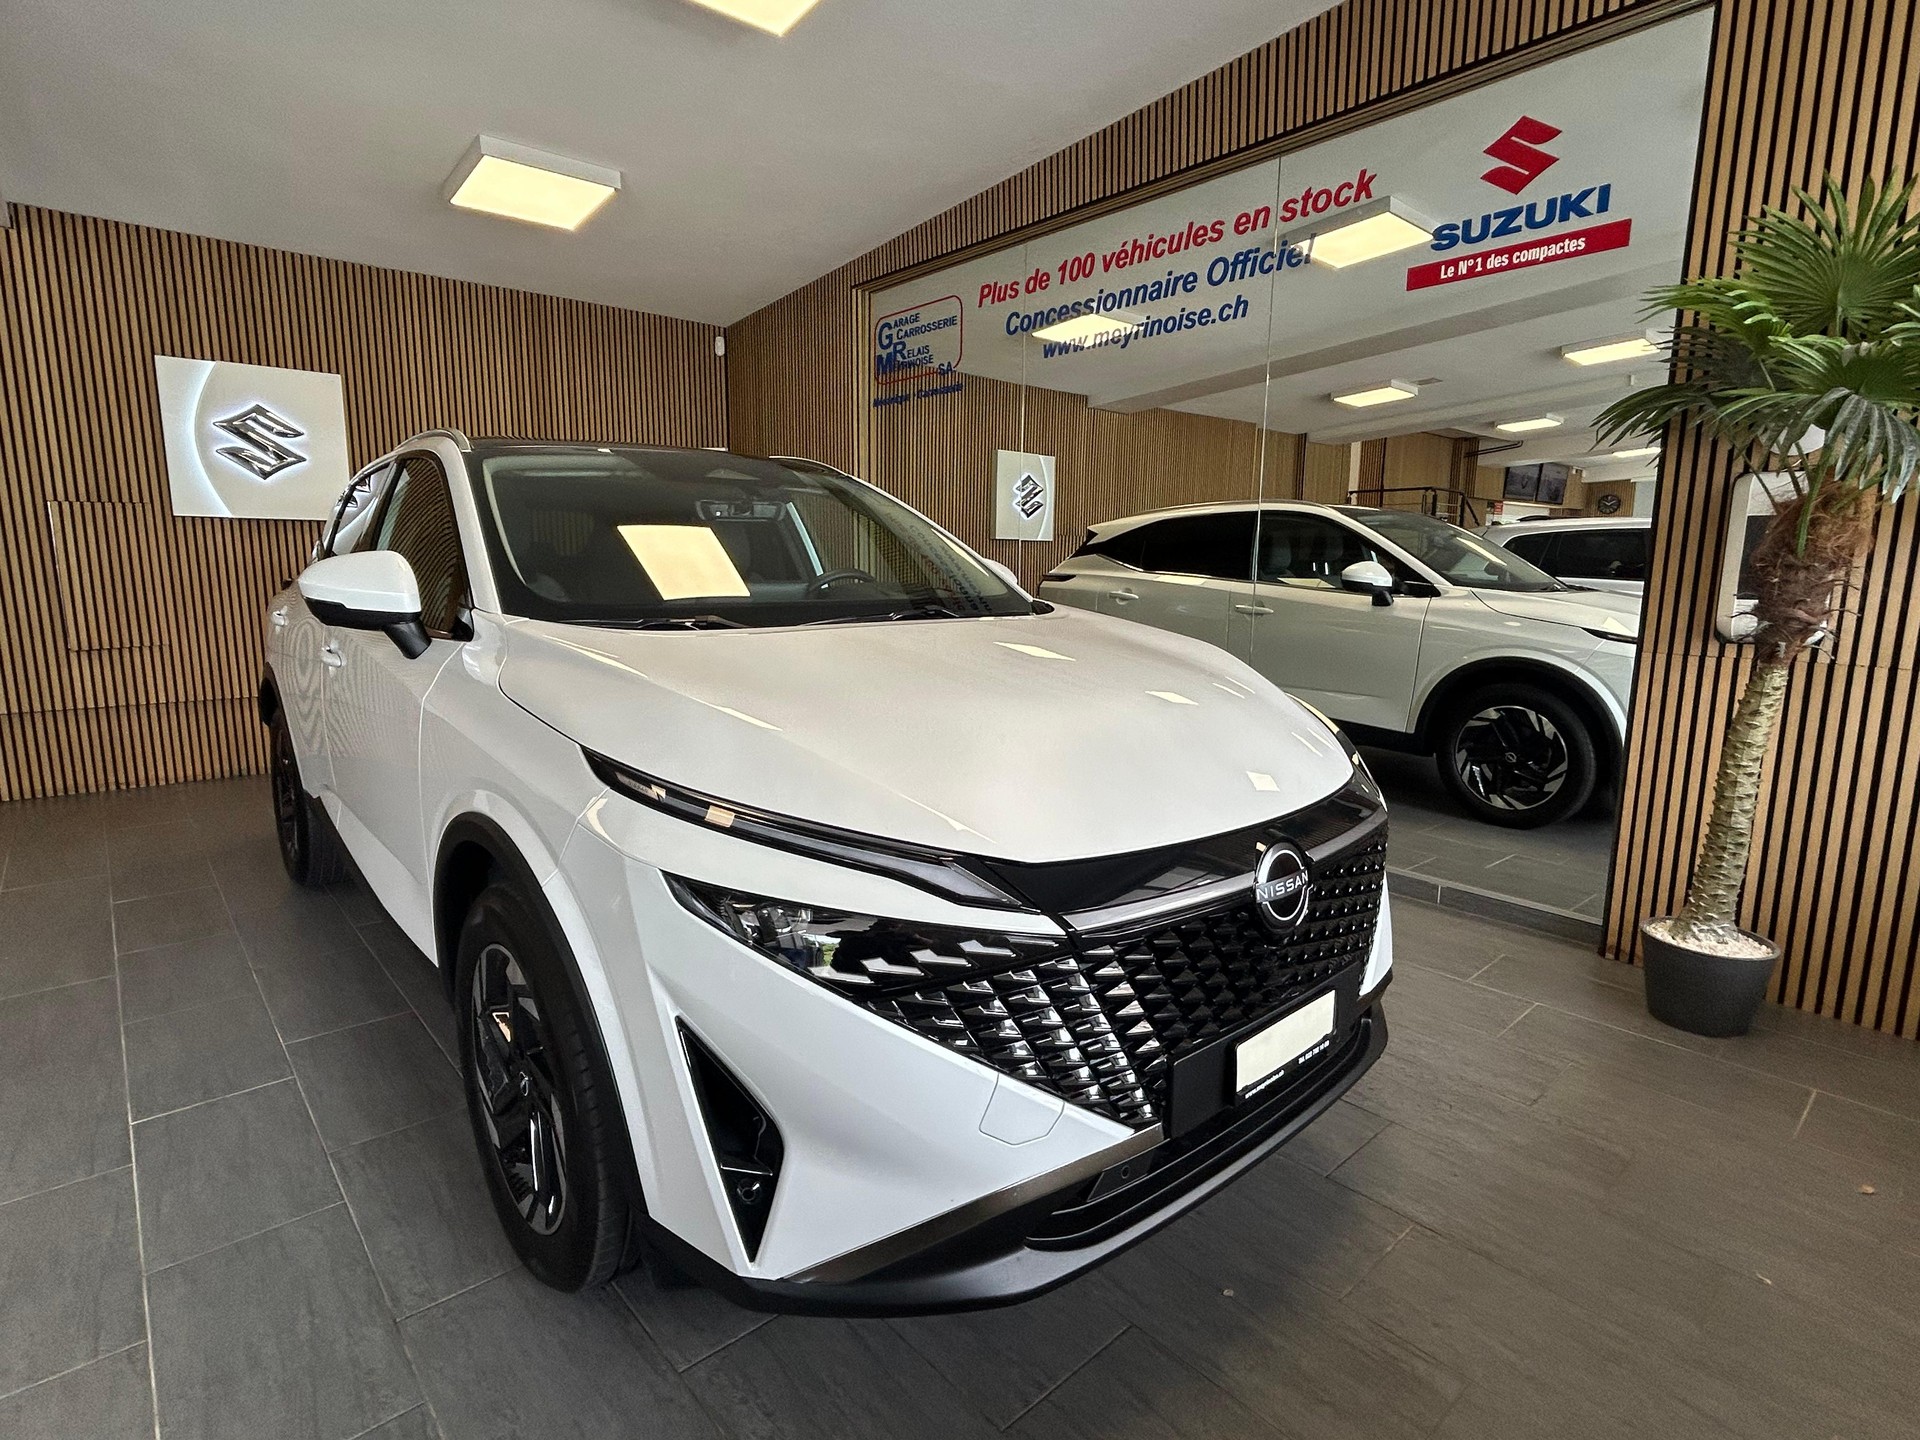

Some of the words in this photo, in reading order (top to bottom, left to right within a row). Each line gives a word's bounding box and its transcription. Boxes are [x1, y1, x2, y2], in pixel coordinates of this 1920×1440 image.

[977, 281, 1020, 308] Plus
[1024, 268, 1051, 294] de
[1057, 252, 1095, 285] 100
[1101, 220, 1226, 273] véhicules
[1233, 205, 1271, 235] en
[1279, 168, 1377, 223] stock
[1430, 183, 1611, 250] SUZUKI
[1006, 270, 1198, 335] Concessionnaire
[1206, 232, 1317, 287] Officiel
[1440, 264, 1455, 280] Le
[1458, 257, 1483, 276] N°1
[1486, 253, 1509, 270] des
[1512, 237, 1586, 264] compactes
[896, 315, 958, 340] CARROSSERIE
[1043, 295, 1249, 358] www.meyrinoise.ch
[1257, 870, 1308, 901] NISSAN
